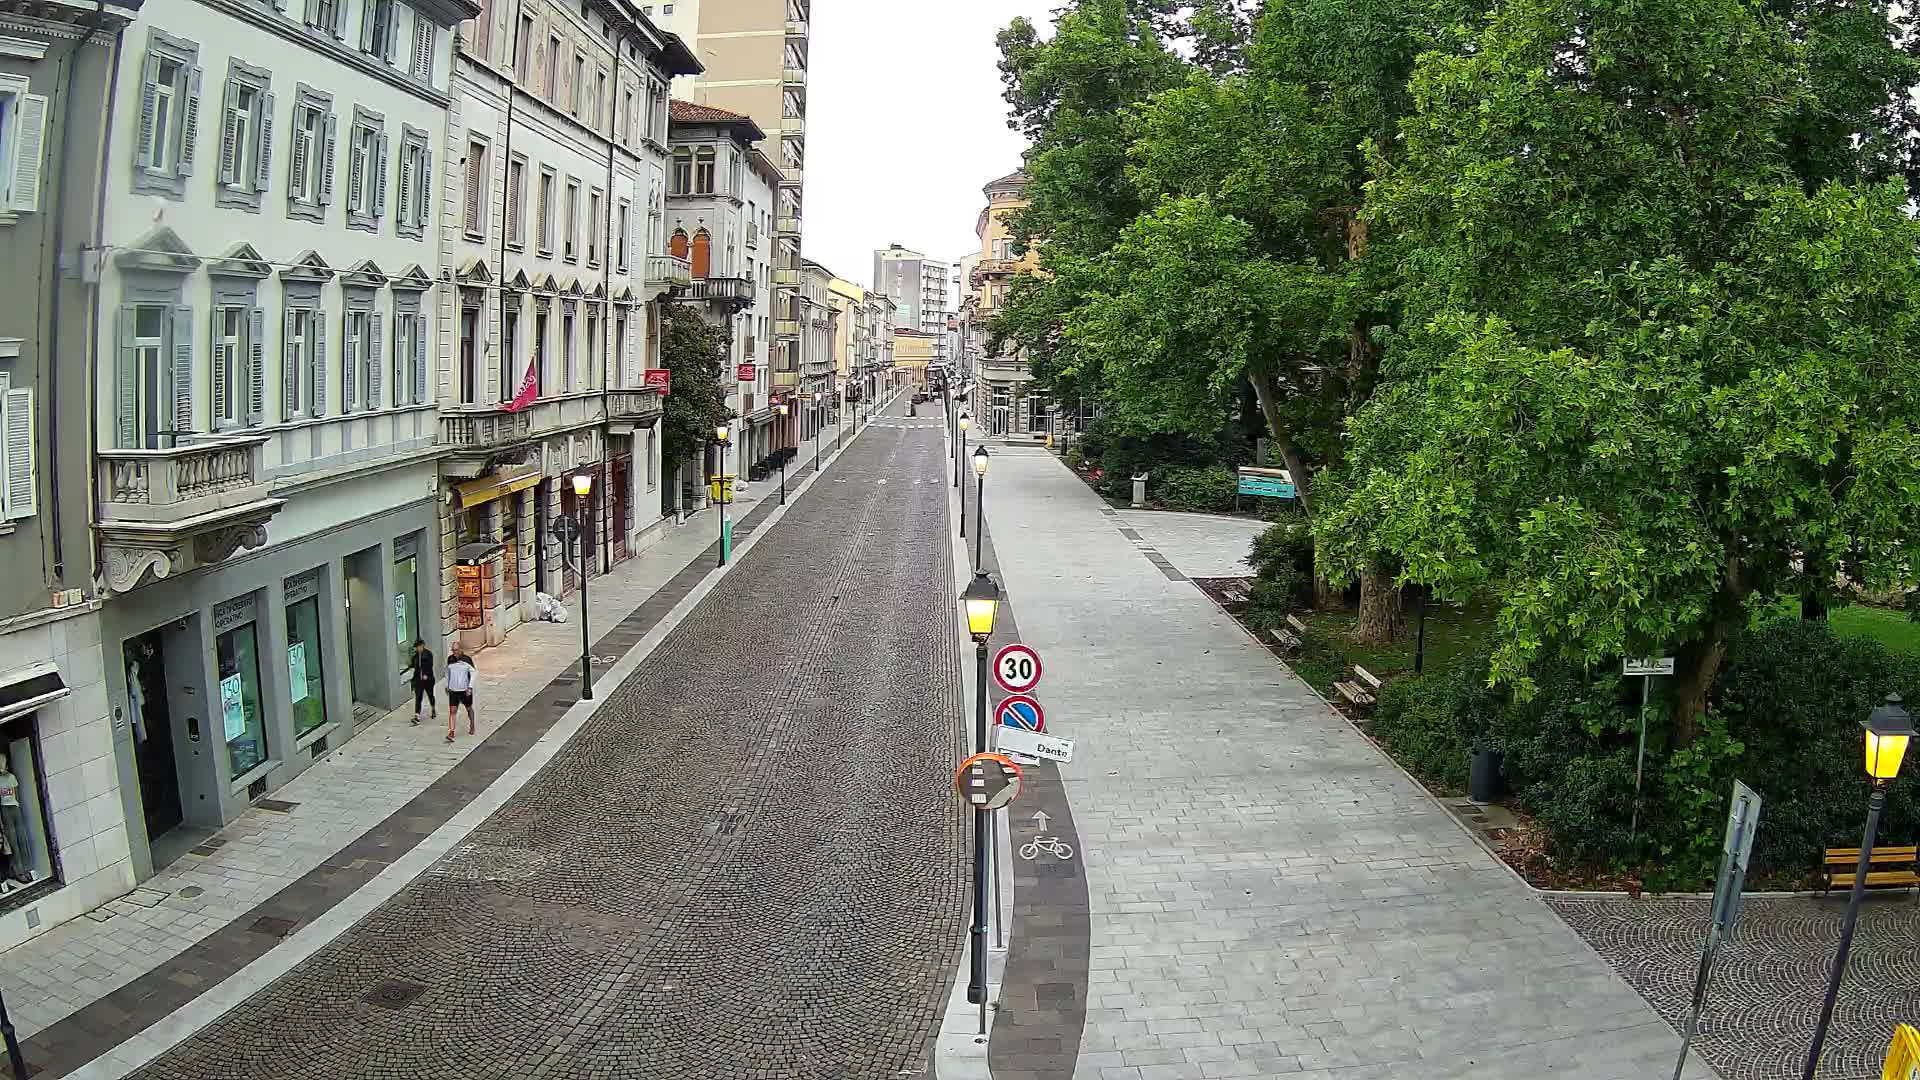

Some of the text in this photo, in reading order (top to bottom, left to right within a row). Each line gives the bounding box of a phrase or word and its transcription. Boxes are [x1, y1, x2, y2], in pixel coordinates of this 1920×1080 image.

[1005, 657, 1032, 680] 30
[222, 678, 240, 701] 130
[1037, 743, 1068, 758] Dante
